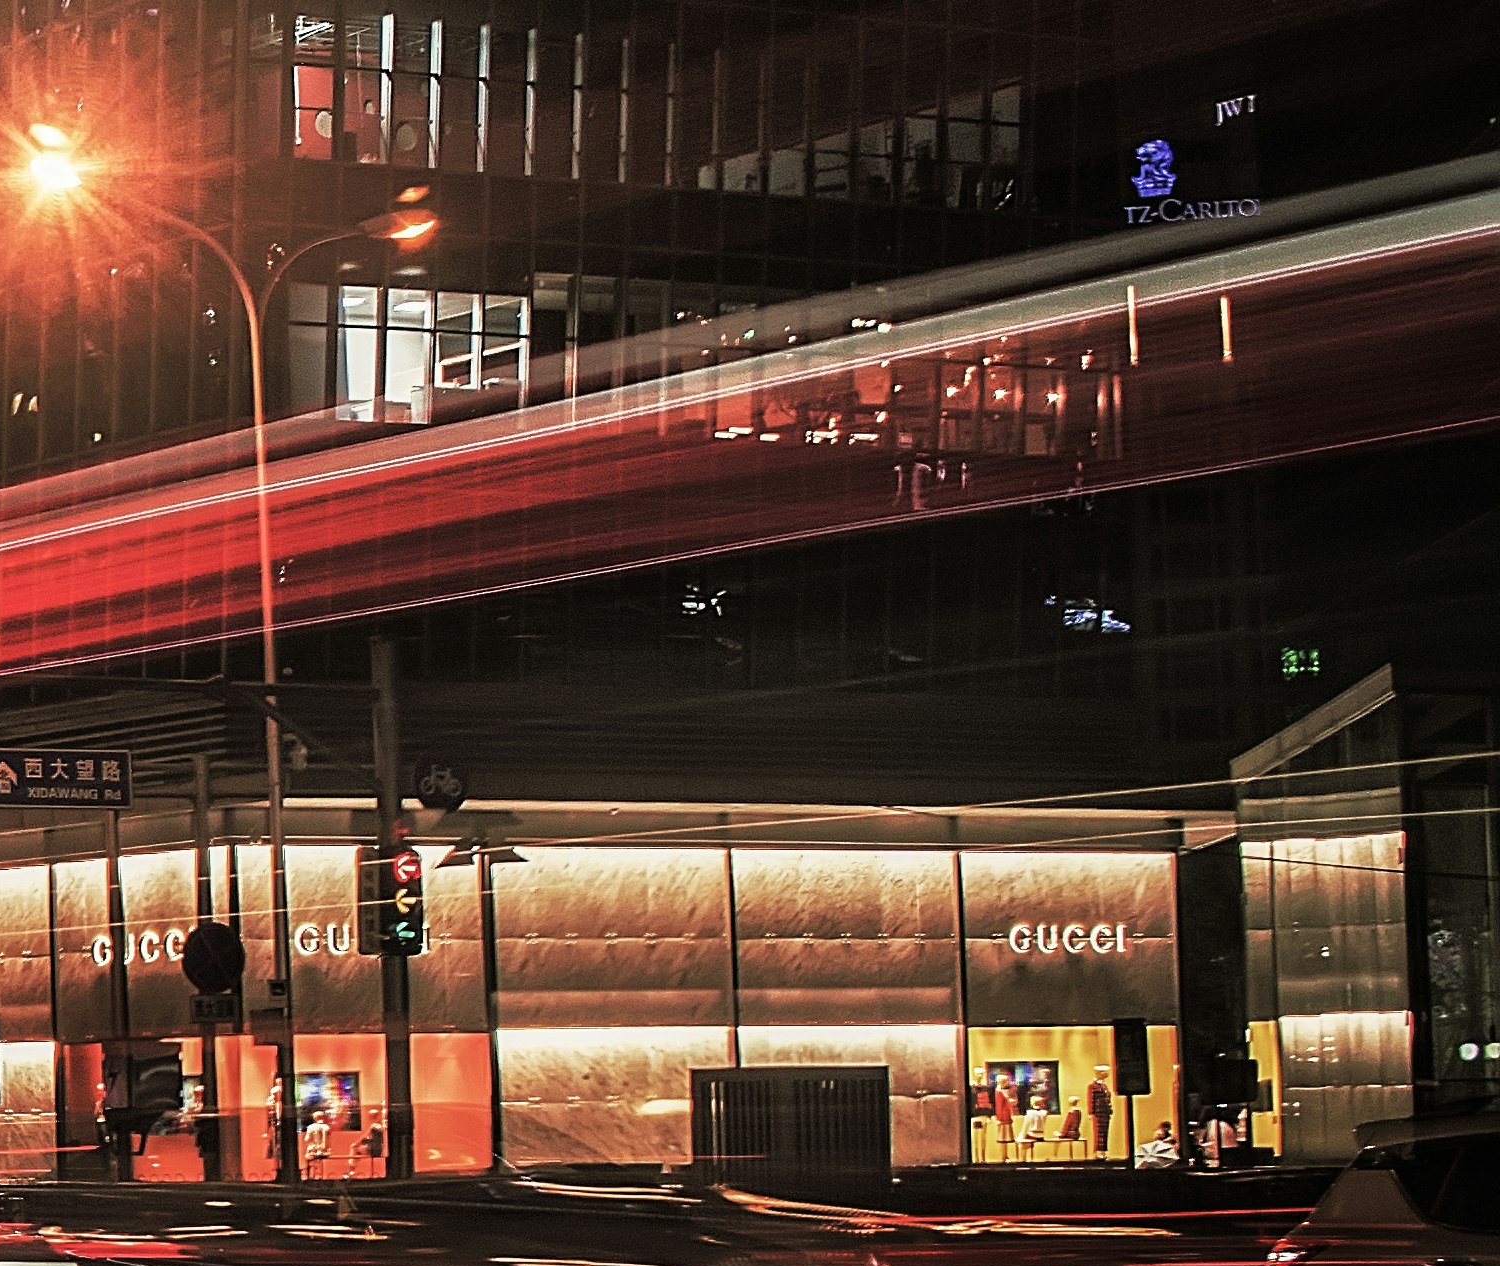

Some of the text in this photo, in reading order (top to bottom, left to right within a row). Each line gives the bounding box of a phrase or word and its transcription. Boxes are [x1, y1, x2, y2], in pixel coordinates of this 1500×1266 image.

[23, 757, 121, 782] 西大望路
[28, 787, 122, 801] XIDAWANG Rd
[92, 926, 197, 967] GUCC
[294, 922, 431, 956] GUI
[1009, 922, 1128, 954] GUCCI
